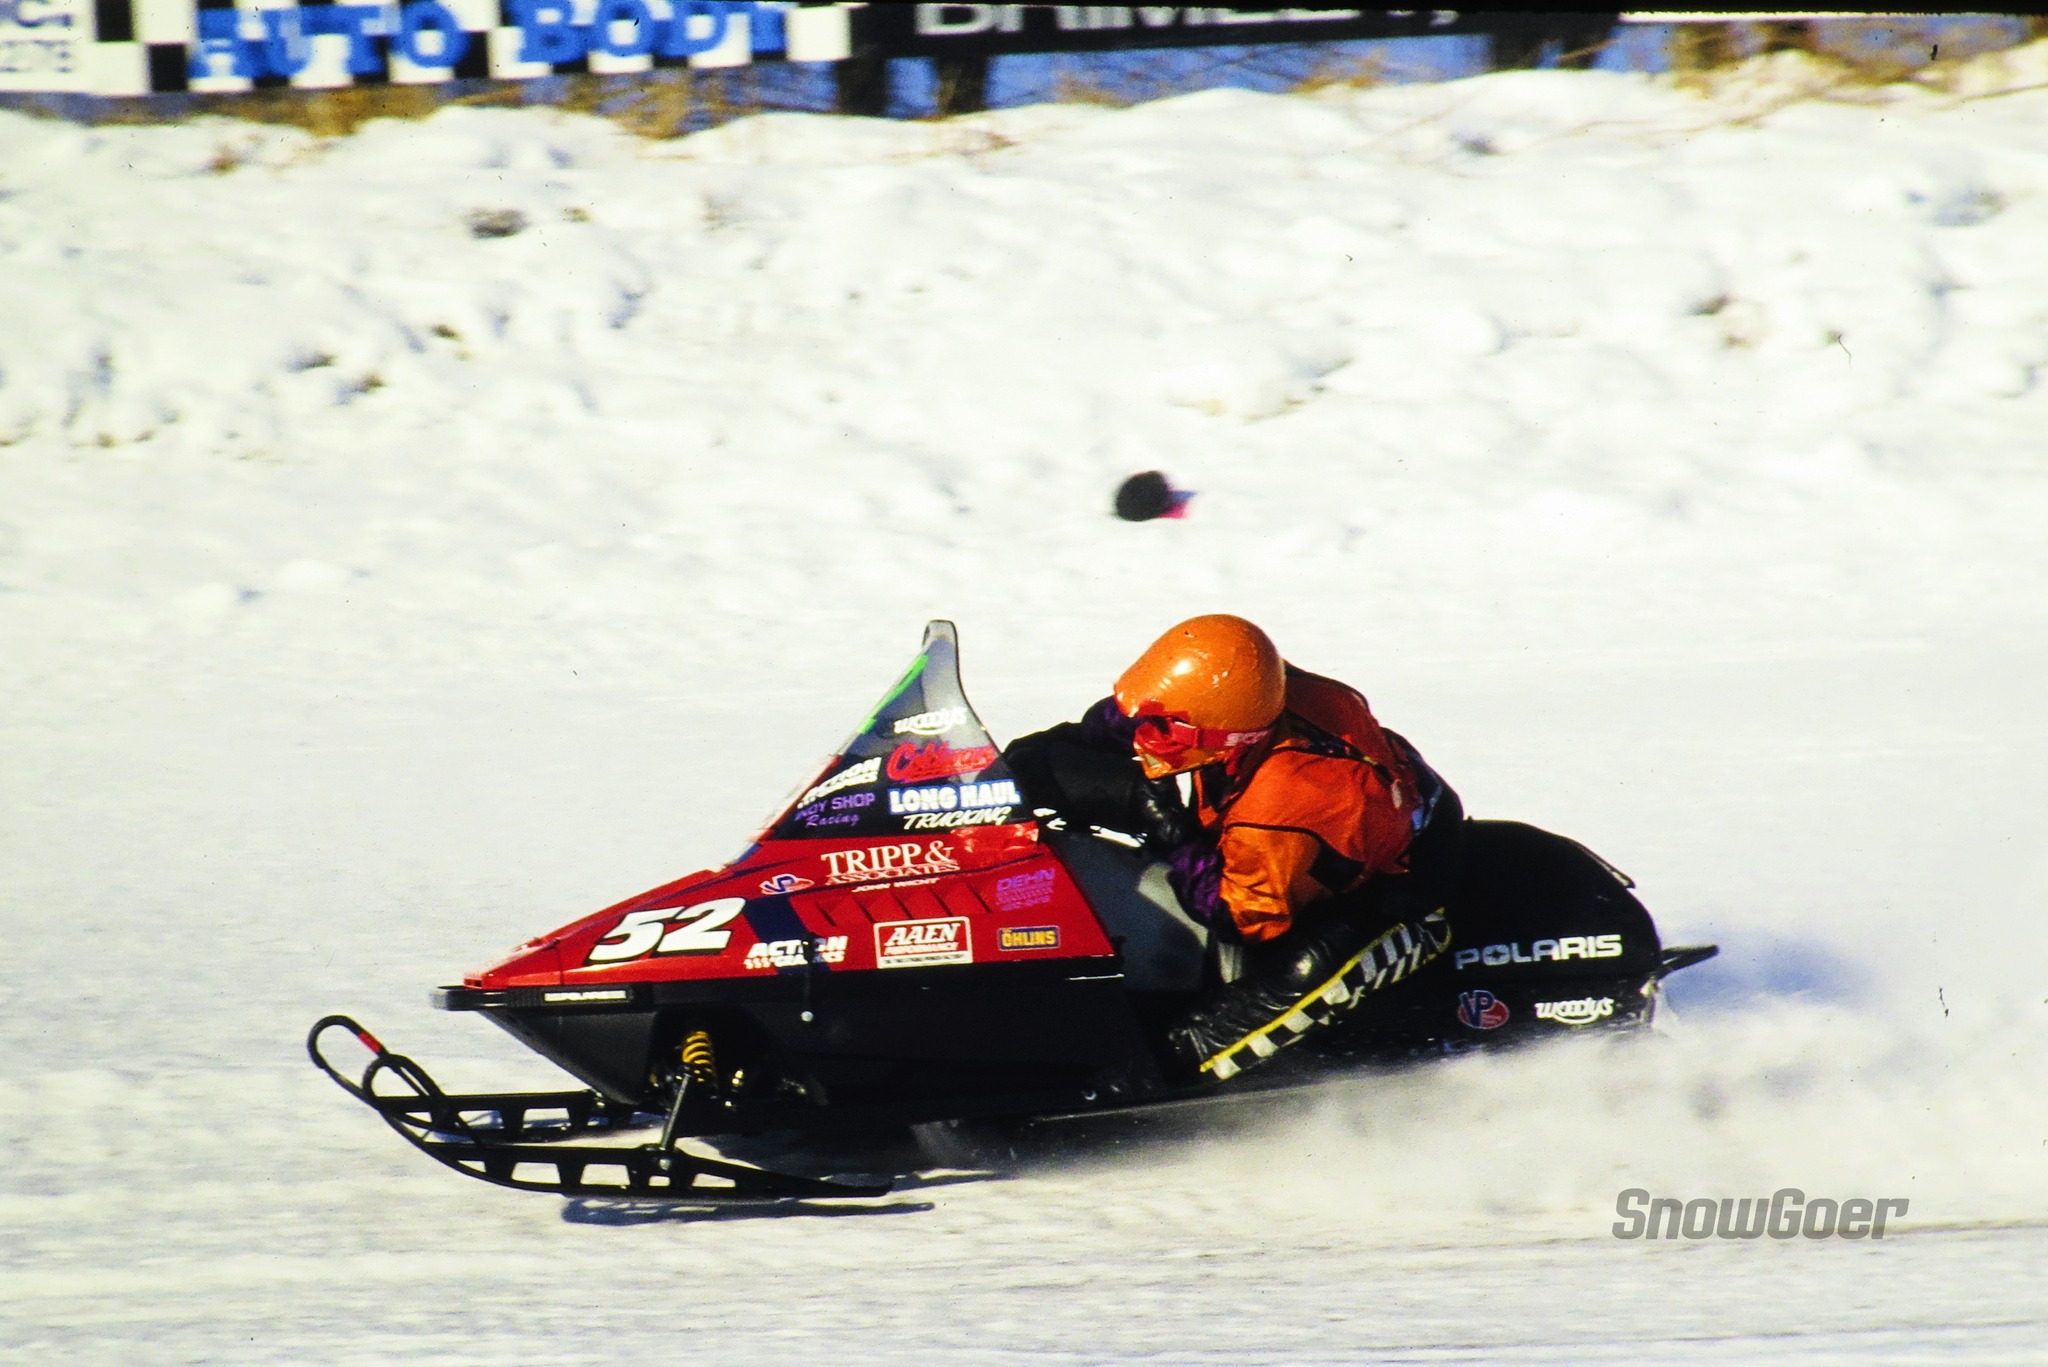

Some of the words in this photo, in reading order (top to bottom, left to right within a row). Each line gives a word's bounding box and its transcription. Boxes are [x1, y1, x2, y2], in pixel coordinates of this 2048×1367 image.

[187, 1, 472, 78] AUTO
[831, 792, 876, 810] SHOP
[890, 785, 957, 812] LONG
[960, 781, 1021, 808] HAUL
[805, 814, 860, 828] Racing
[903, 806, 1012, 830] TRUCKING
[821, 843, 921, 876] TRIPP
[925, 840, 954, 864] &
[825, 862, 960, 885] ASSOCIATES
[588, 898, 747, 963] 52
[884, 923, 961, 946] AAEN
[1455, 934, 1622, 970] POLARIS
